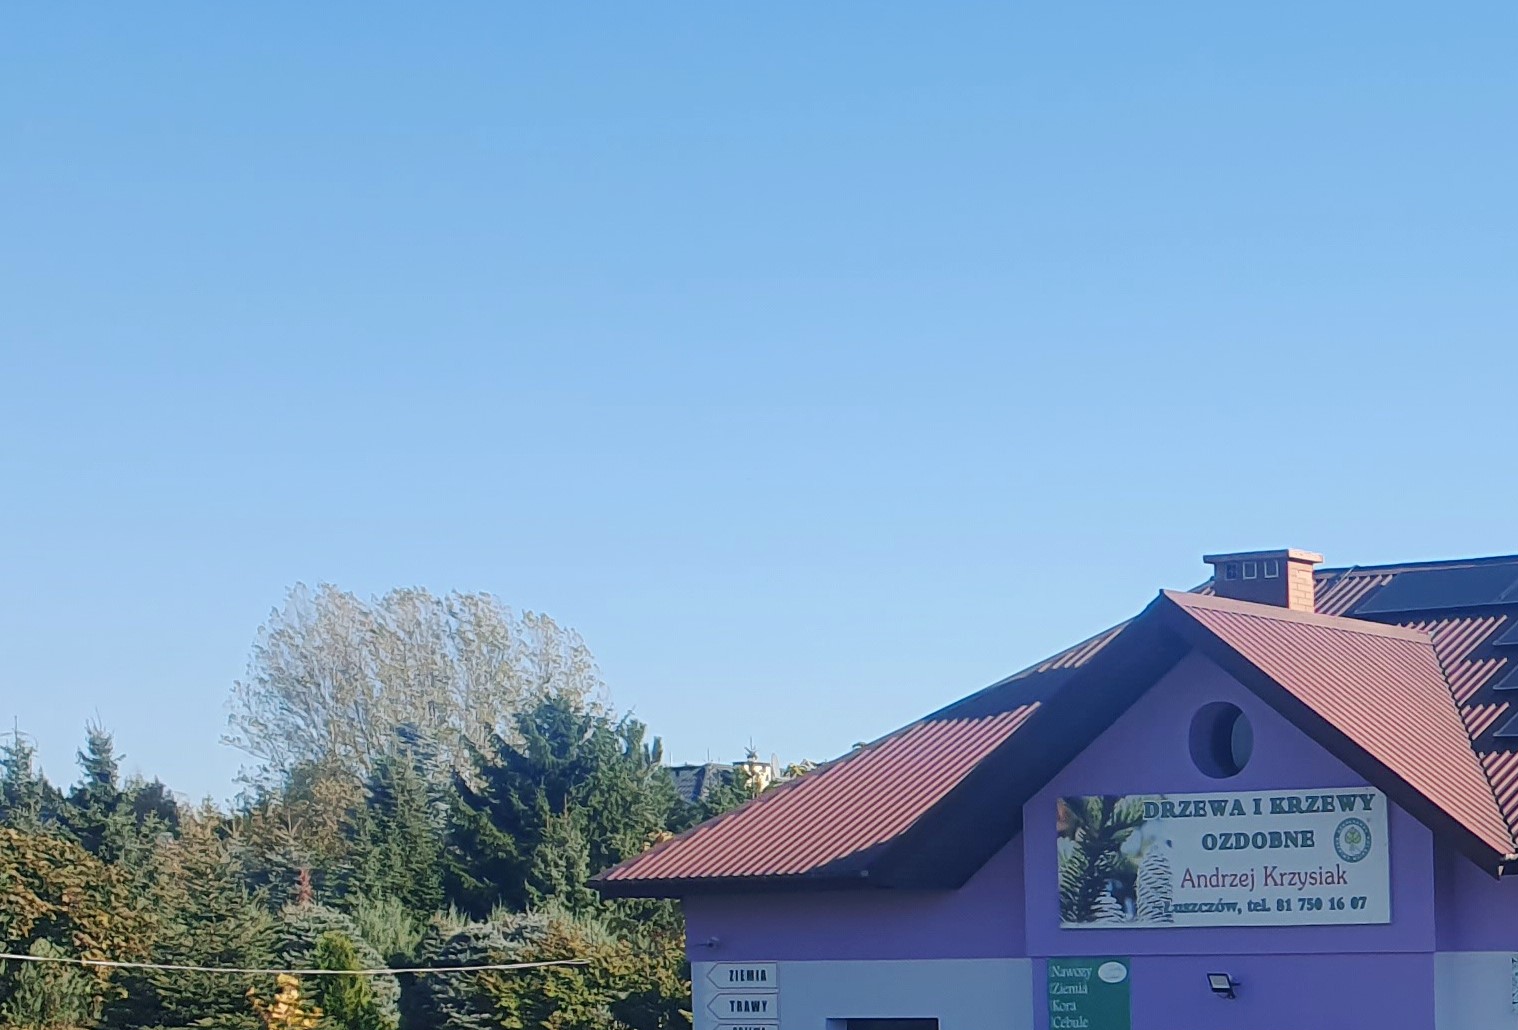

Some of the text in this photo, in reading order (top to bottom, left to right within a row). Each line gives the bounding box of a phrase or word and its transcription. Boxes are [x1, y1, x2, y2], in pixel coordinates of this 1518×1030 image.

[1143, 793, 1376, 819] DRZEWA I KRZEWY
[1201, 830, 1315, 851] OZDOBNE
[1180, 864, 1348, 892] Andrzej Krzysiak
[1247, 898, 1271, 912] tel.
[1276, 898, 1292, 912] 81
[1298, 897, 1323, 911] 750
[1329, 896, 1345, 911] 16
[1350, 896, 1368, 910] 07
[729, 969, 767, 981] ZIEMIA
[1050, 982, 1088, 994] Ziemia
[729, 1000, 768, 1012] TRAWY
[1052, 1000, 1077, 1012] Kora
[1052, 1016, 1088, 1028] Cebule
